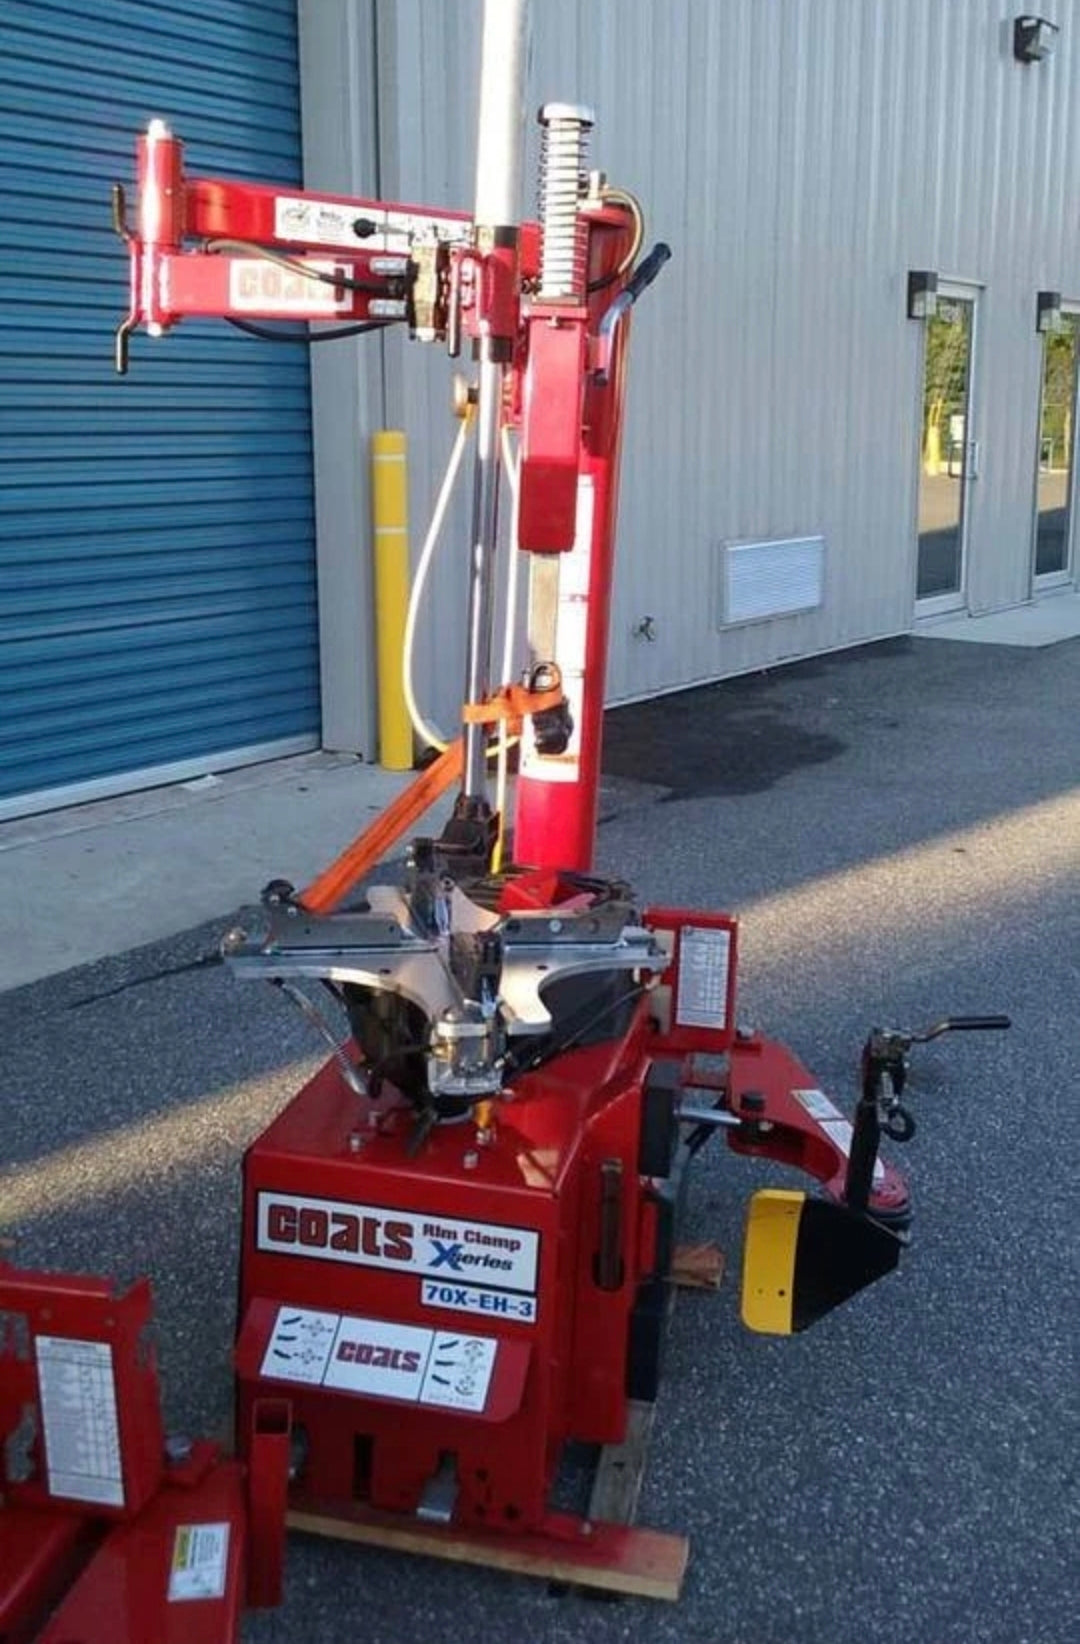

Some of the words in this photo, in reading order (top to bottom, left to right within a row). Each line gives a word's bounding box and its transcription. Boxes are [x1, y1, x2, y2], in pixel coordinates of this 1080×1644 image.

[423, 1223, 457, 1240] Rim
[463, 1230, 521, 1253] Clamp
[425, 1284, 533, 1317] 70X-EH-3
